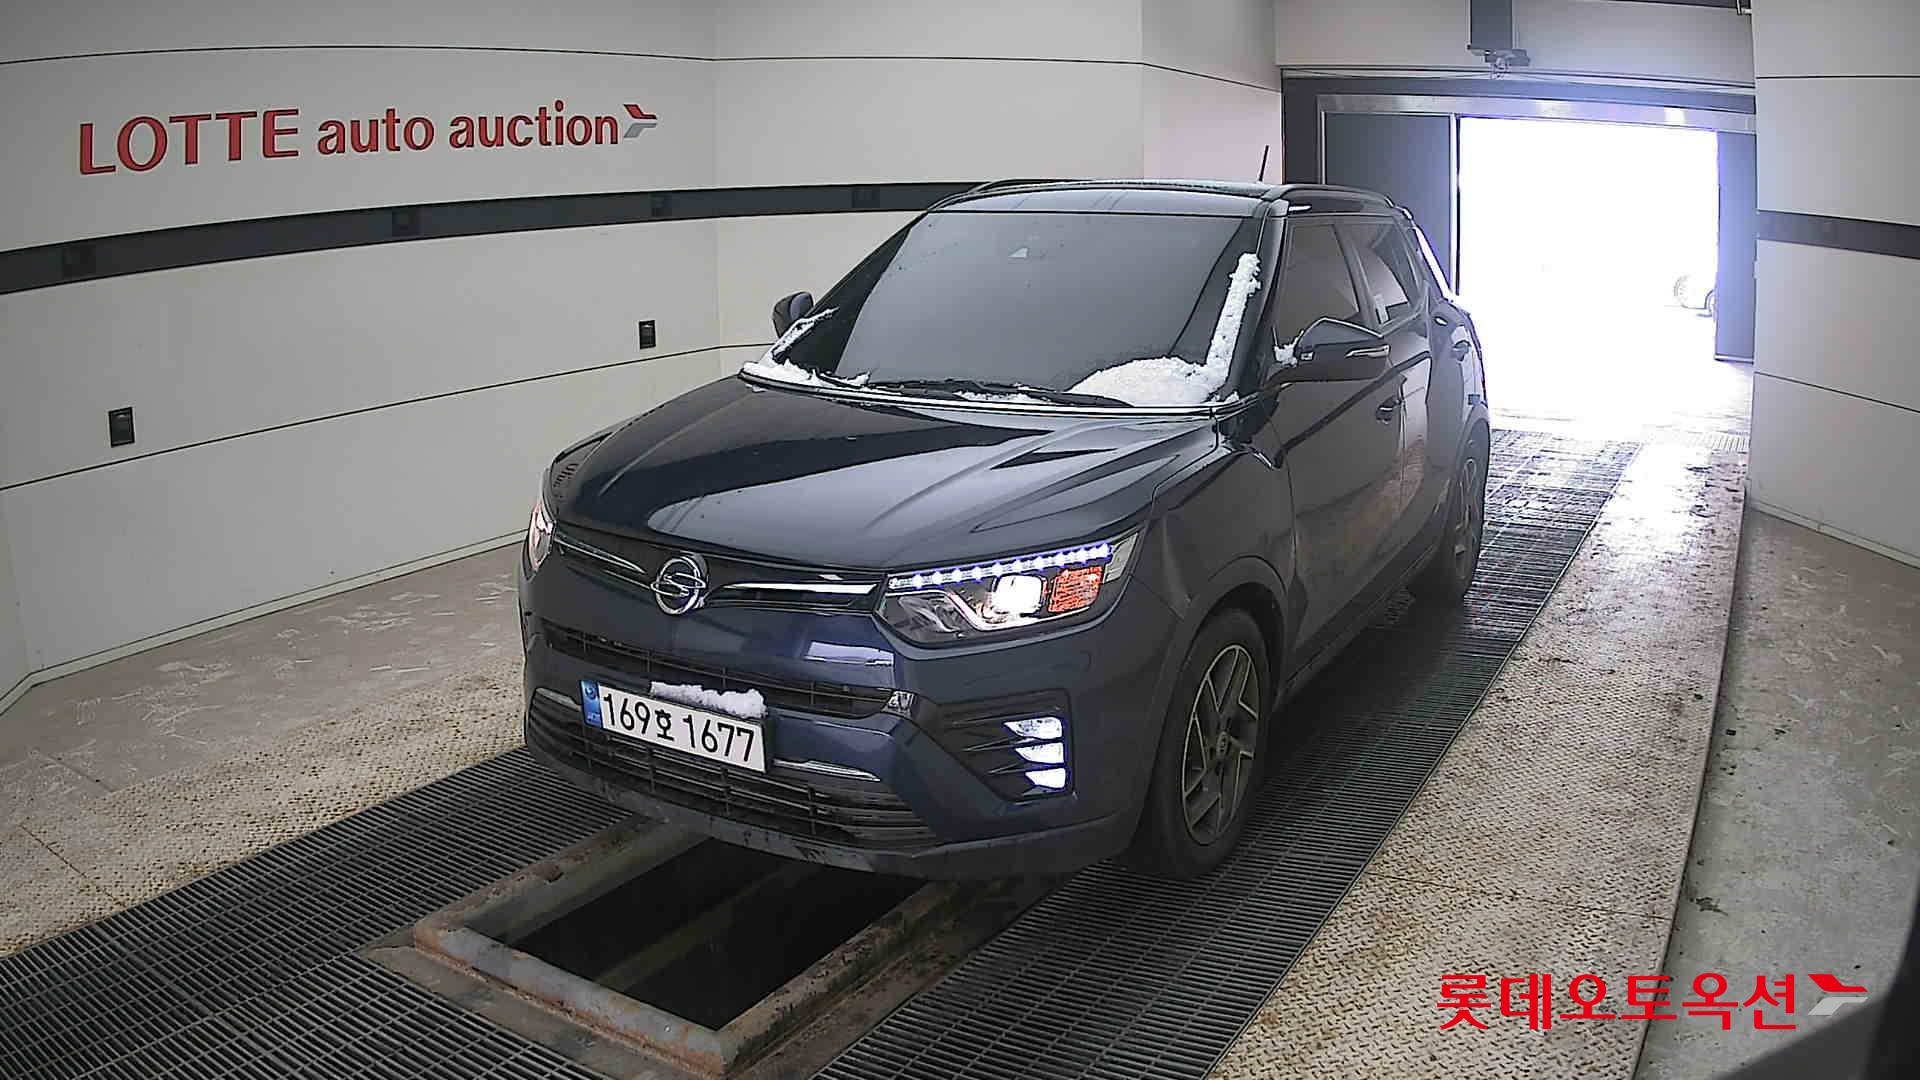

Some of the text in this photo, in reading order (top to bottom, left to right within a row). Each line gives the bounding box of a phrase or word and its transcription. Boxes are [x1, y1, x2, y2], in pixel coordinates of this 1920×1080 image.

[79, 100, 619, 175] LOTTE auto auction
[604, 693, 754, 762] 169호 1677
